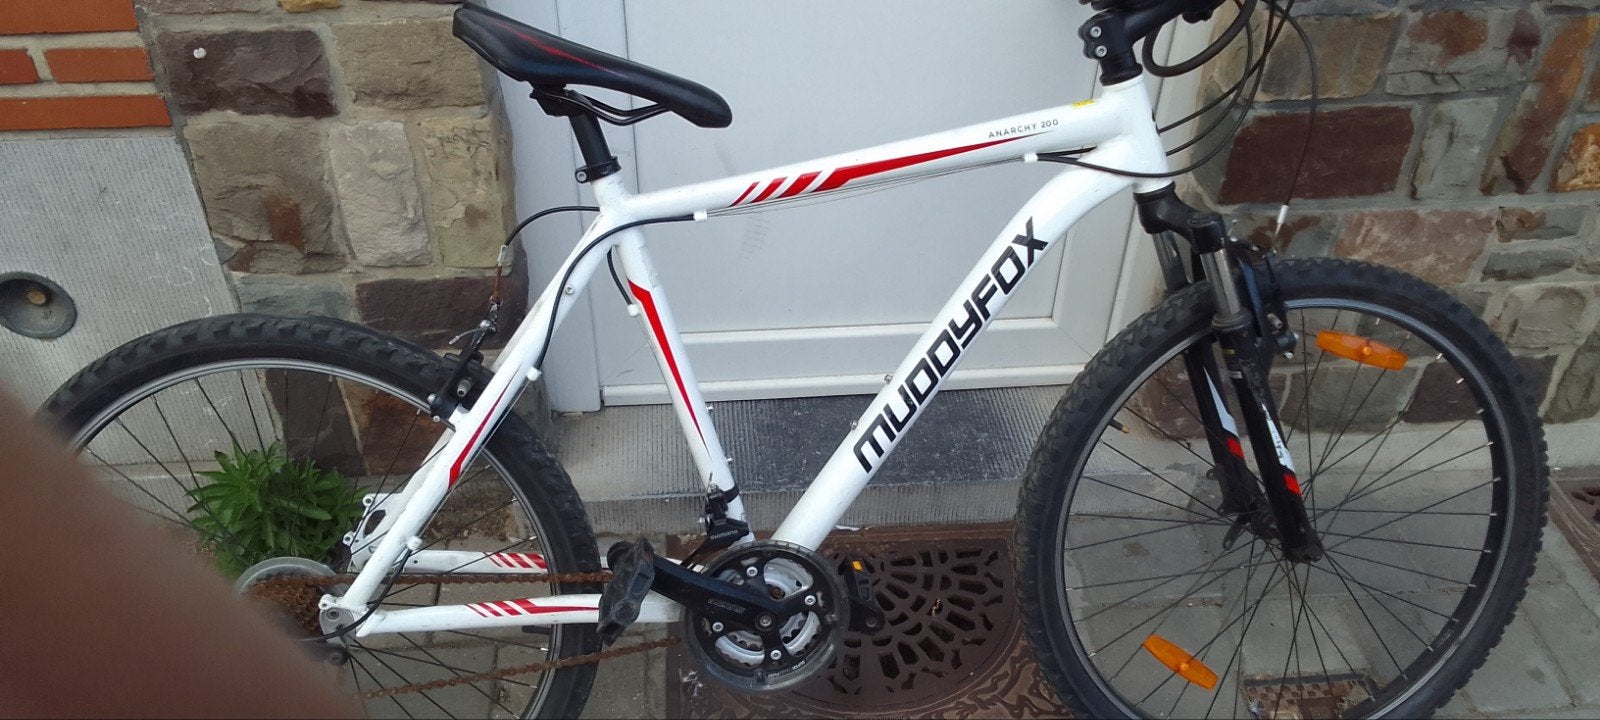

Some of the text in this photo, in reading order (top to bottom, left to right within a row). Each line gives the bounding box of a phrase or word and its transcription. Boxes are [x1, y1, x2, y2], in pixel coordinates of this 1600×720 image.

[988, 119, 1059, 139] ANARCHY 200
[853, 216, 1049, 474] MUDDYFOX
